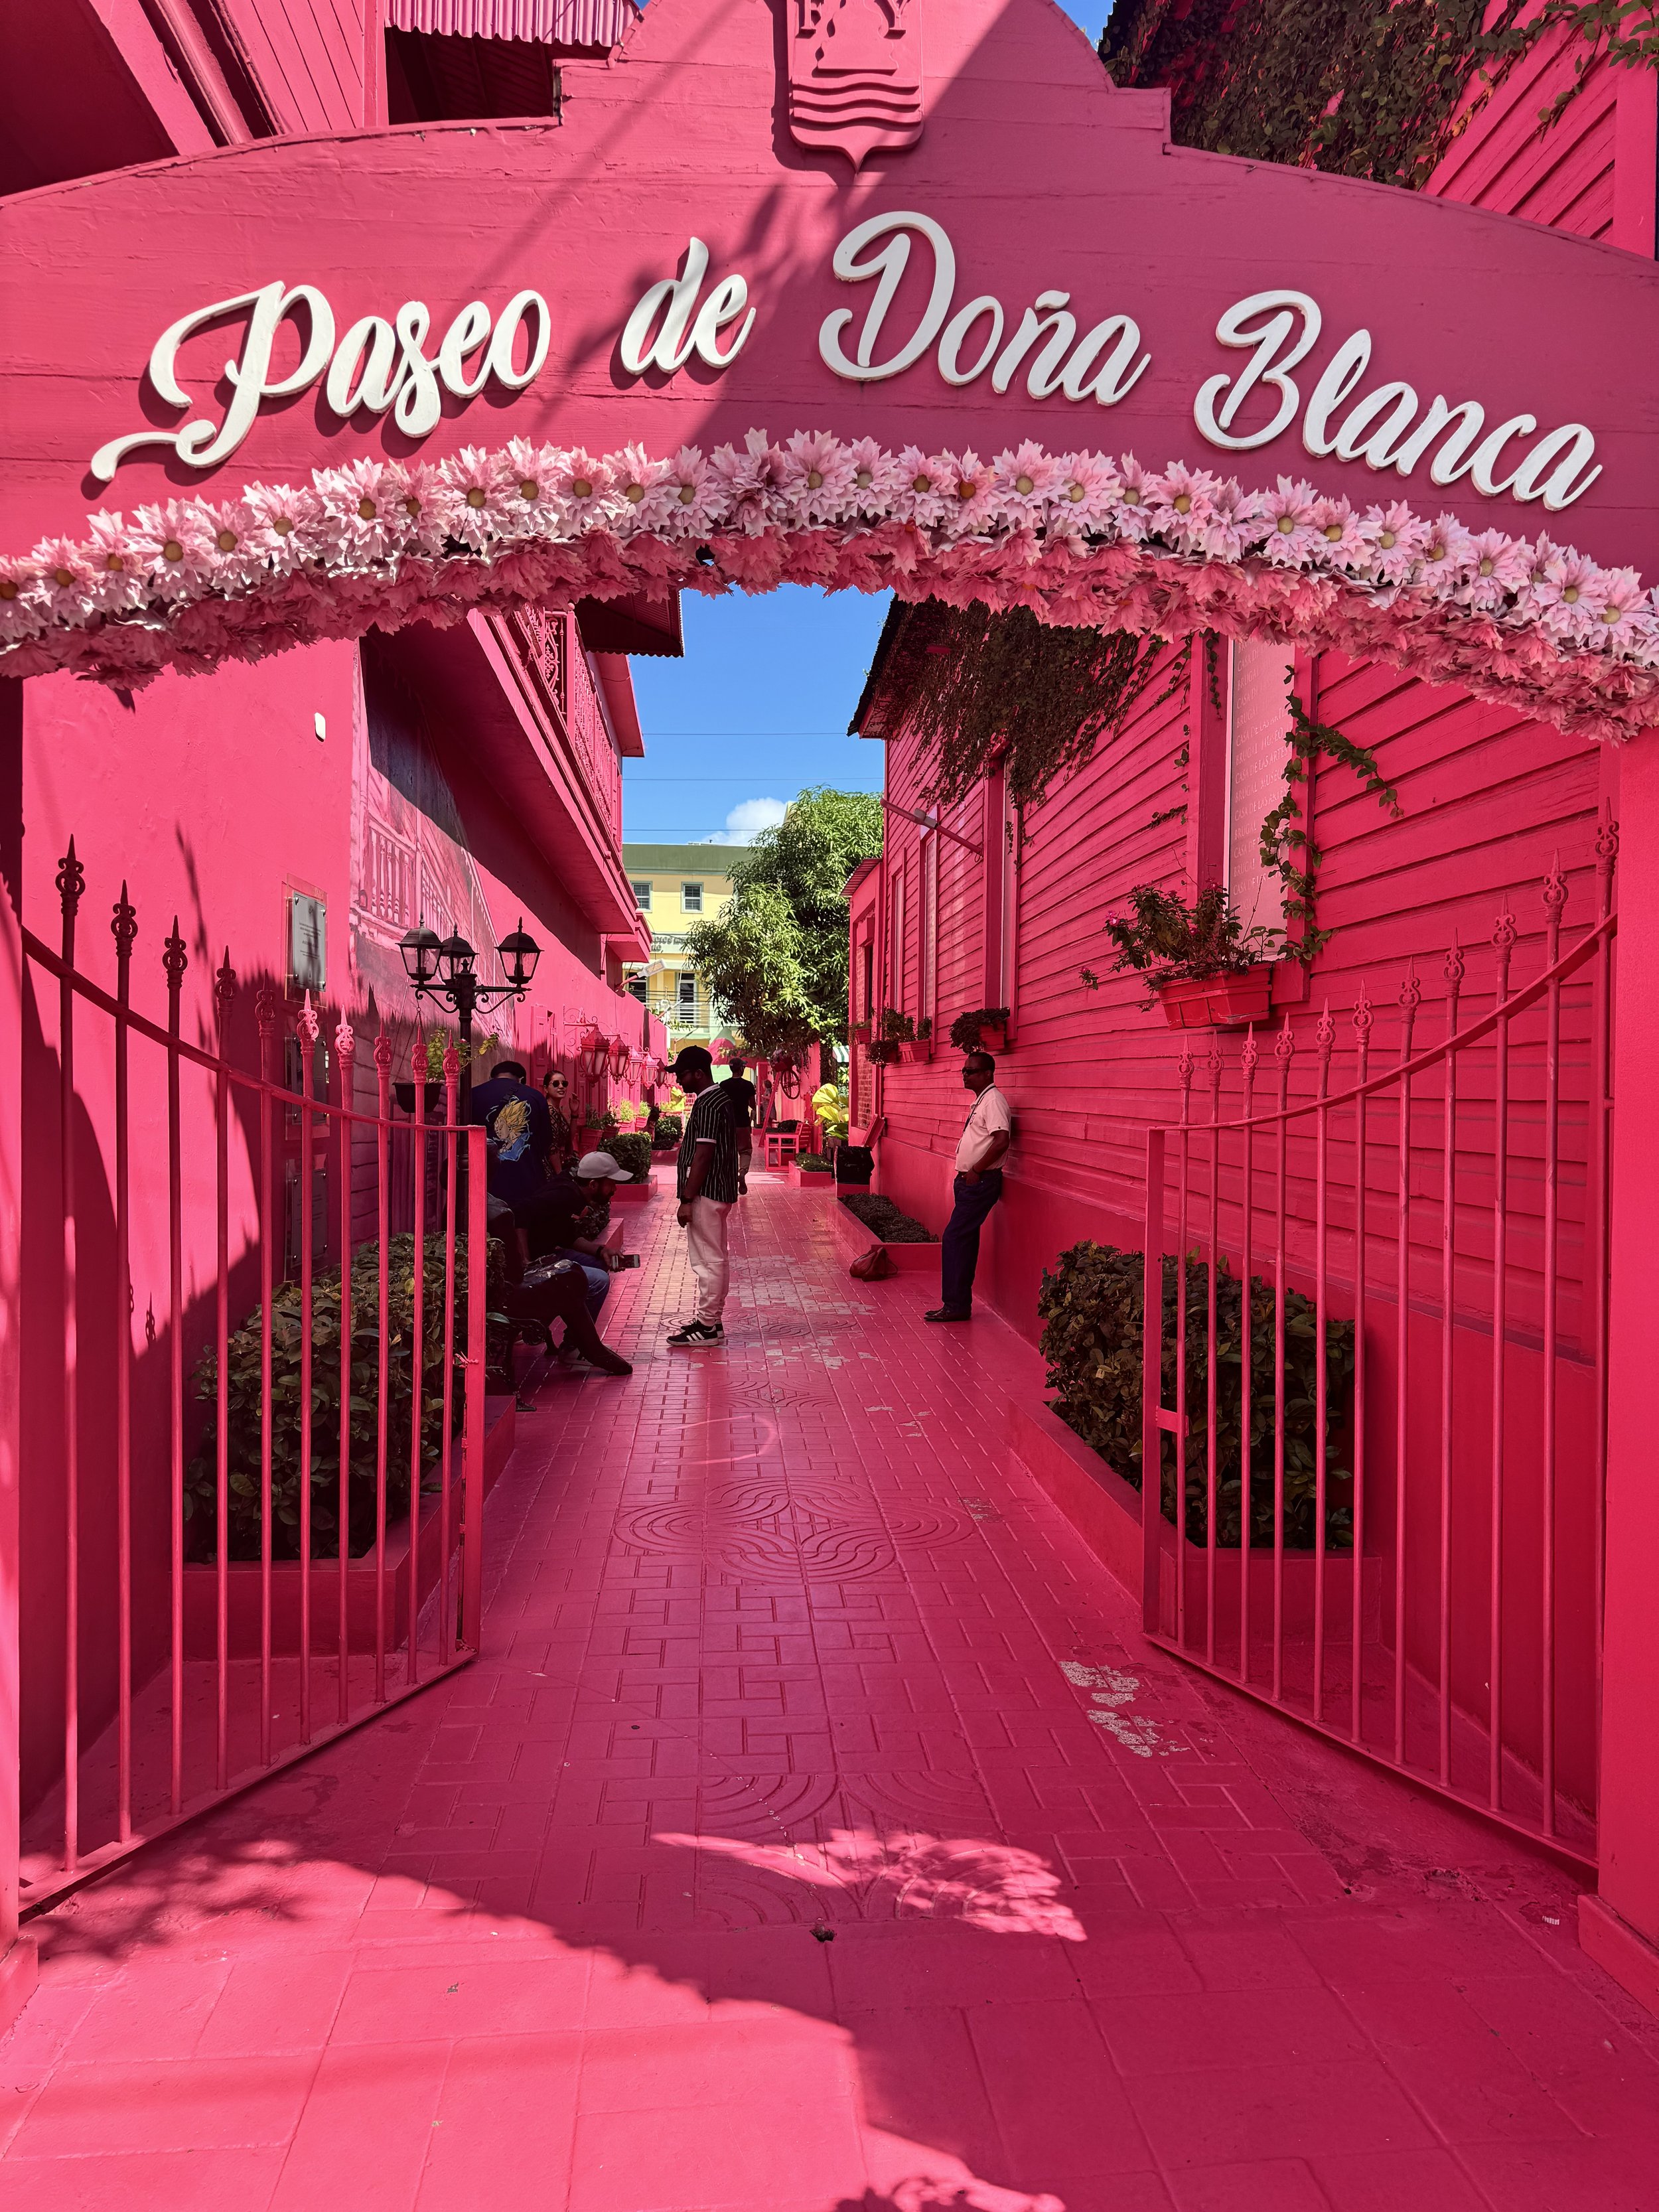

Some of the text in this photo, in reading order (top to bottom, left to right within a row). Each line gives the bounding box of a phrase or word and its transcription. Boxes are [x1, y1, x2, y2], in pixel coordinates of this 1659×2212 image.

[91, 210, 1603, 512] Paseo de Doña Blanca
